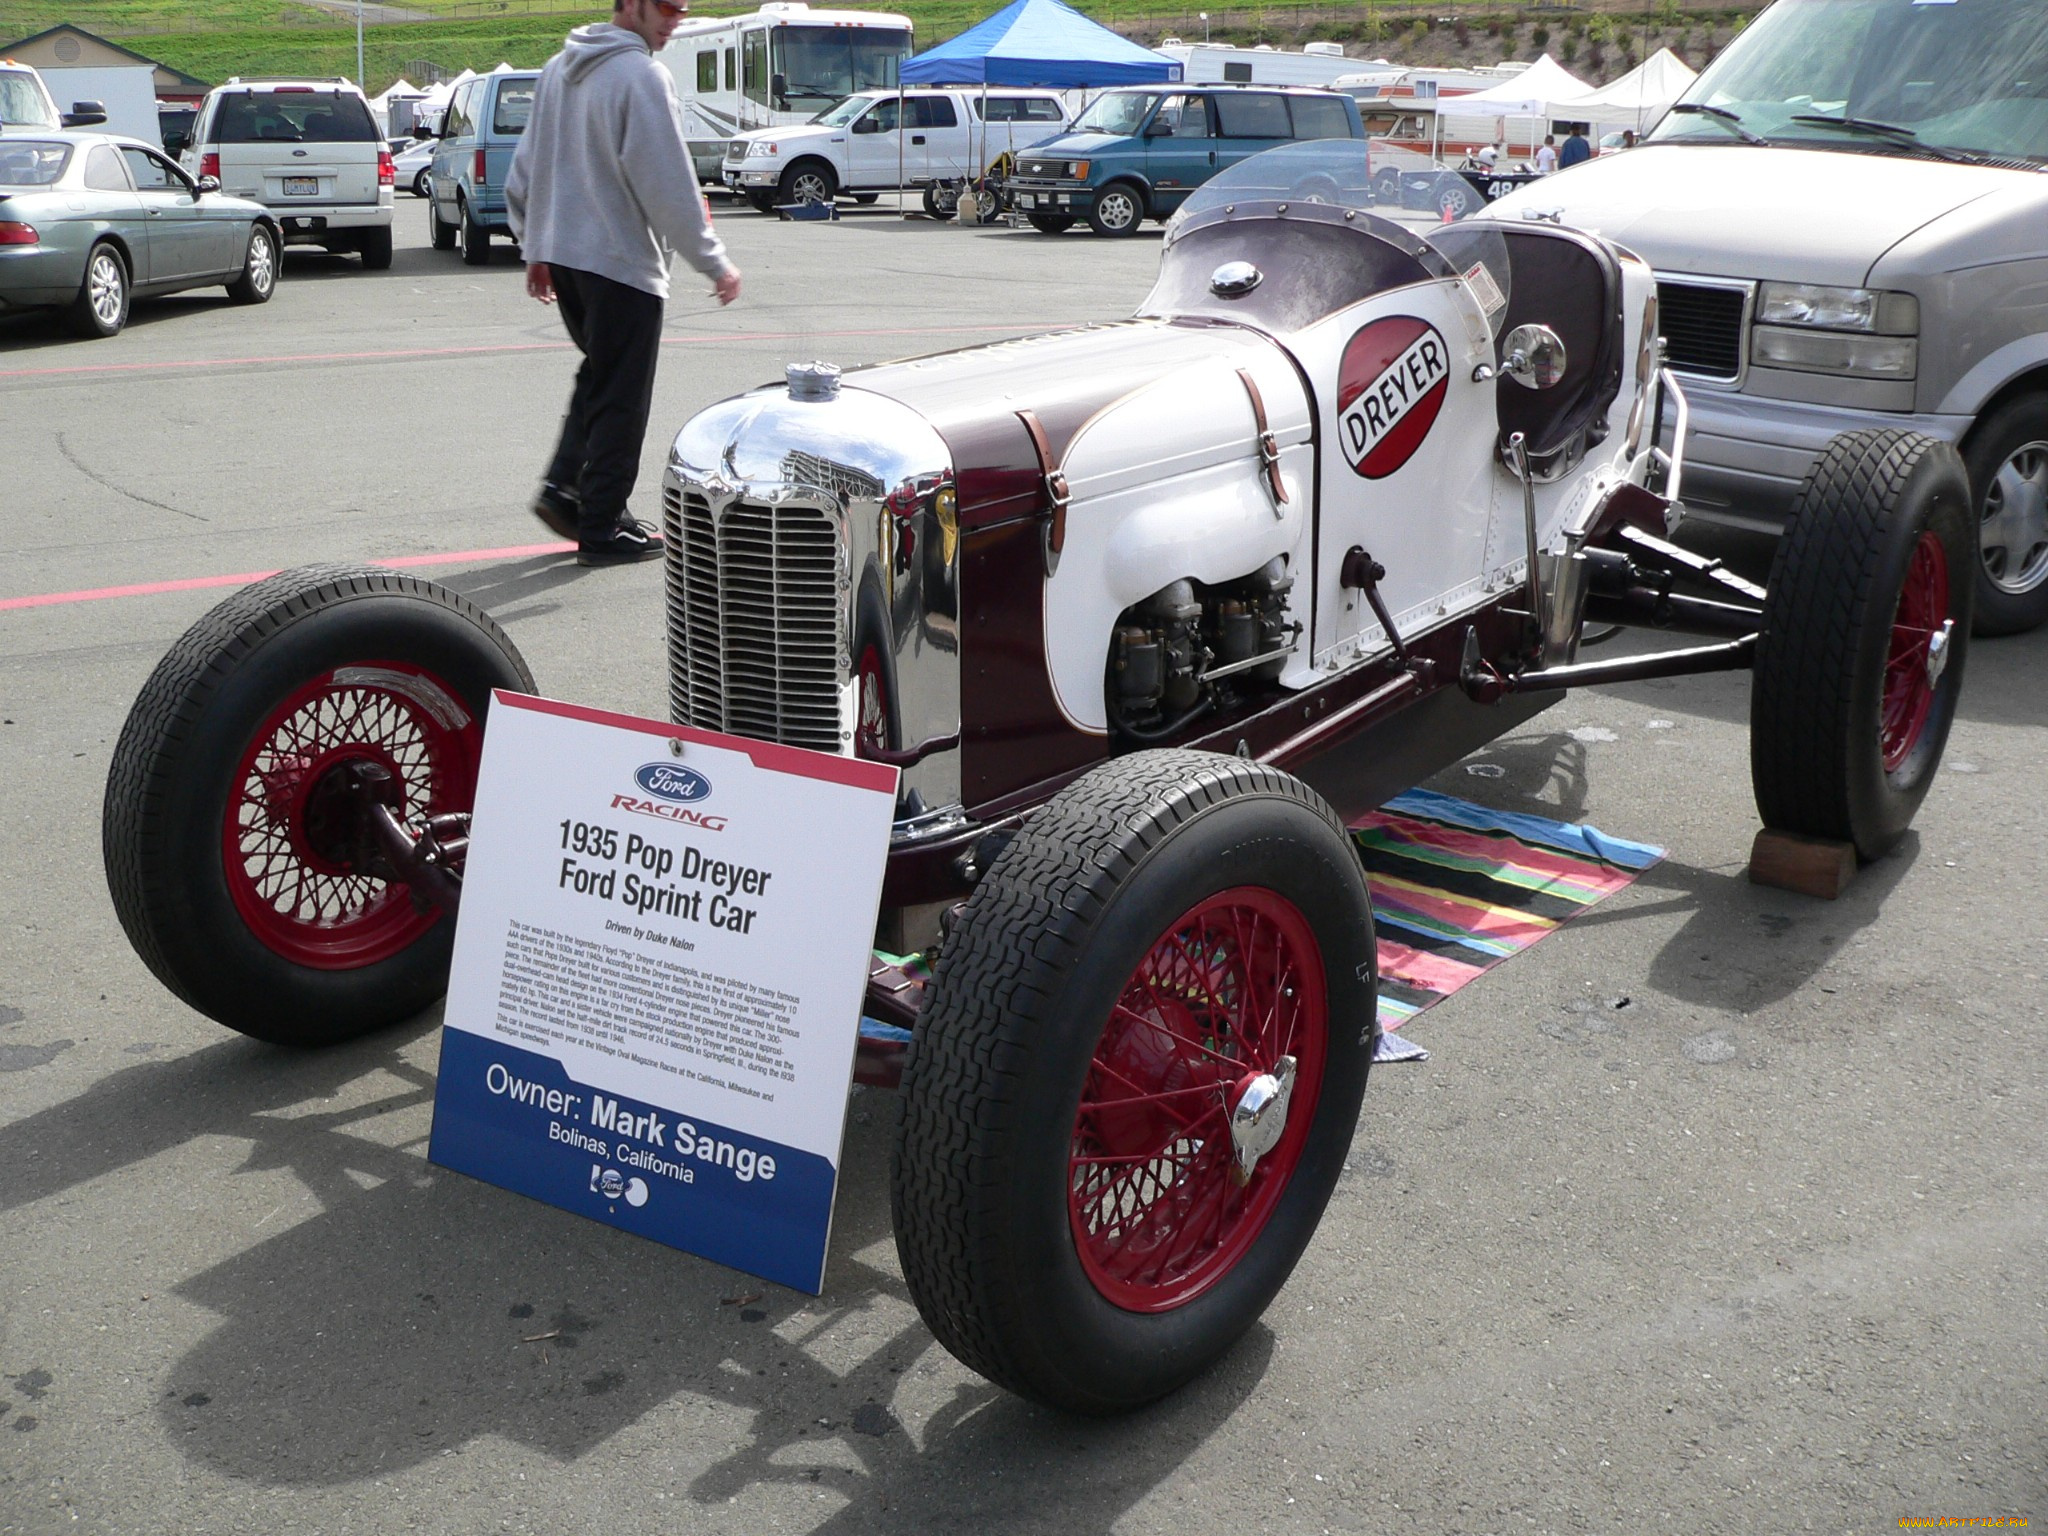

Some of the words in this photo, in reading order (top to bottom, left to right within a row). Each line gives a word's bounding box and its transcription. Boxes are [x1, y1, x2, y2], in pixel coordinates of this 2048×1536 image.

[1346, 340, 1443, 456] DREYER
[610, 794, 728, 831] RACING
[649, 767, 697, 797] Ford
[560, 819, 618, 860] 1935
[625, 834, 672, 879] Pop
[681, 846, 771, 896] Dreyer
[560, 858, 616, 900] Ford
[622, 873, 702, 922] Sprint
[709, 893, 756, 934] Car
[510, 919, 520, 929] This
[531, 927, 542, 935] was
[543, 929, 555, 938] built
[564, 935, 573, 943] the
[574, 937, 601, 952] legendary
[602, 944, 617, 955] Floyd
[636, 953, 655, 965] Dreyer
[701, 972, 712, 980] and
[714, 976, 726, 984] was
[727, 979, 748, 990] piloted
[758, 987, 775, 999] many
[777, 990, 799, 1004] famous
[520, 933, 538, 944] drivers
[546, 940, 554, 949] the
[574, 946, 584, 957] and
[605, 956, 633, 972] According
[642, 966, 651, 975] the
[652, 968, 671, 980] Dreyer
[693, 980, 703, 989] this
[712, 985, 721, 994] the
[723, 988, 735, 998] first
[605, 919, 632, 935] Driven
[633, 927, 644, 940] by
[646, 930, 668, 944] Duke
[669, 936, 694, 951] Nalon
[520, 1005, 529, 1015] The
[530, 1010, 547, 1021] record
[566, 1020, 579, 1030] from
[522, 954, 531, 963] The
[568, 967, 576, 976] the
[591, 974, 602, 983] had
[655, 991, 674, 1003] Dreyer
[675, 998, 690, 1008] nose
[713, 1007, 733, 1019] Dreyer
[734, 1014, 764, 1028] pioneered
[766, 1022, 775, 1031] his
[777, 1025, 799, 1038] famous
[555, 975, 569, 985] head
[570, 979, 588, 990] design
[598, 987, 607, 995] the
[624, 993, 637, 1004] Ford
[668, 1008, 687, 1018] engine
[689, 1012, 701, 1022] that
[702, 1017, 728, 1029] powered
[729, 1023, 740, 1033] this
[755, 1029, 765, 1040] The
[767, 1033, 781, 1044] 300-
[559, 954, 577, 965] Dreyer
[578, 960, 590, 969] built
[591, 963, 599, 971] for
[652, 980, 663, 989] and
[719, 998, 727, 1007] its
[729, 1002, 749, 1013] unique
[775, 1014, 790, 1024] nose
[559, 986, 568, 995] this
[570, 990, 588, 1001] engine
[601, 998, 609, 1006] far
[610, 1002, 619, 1011] cry
[621, 1004, 633, 1014] from
[635, 1008, 644, 1017] the
[662, 1016, 693, 1030] production
[694, 1026, 714, 1037] engine
[716, 1030, 728, 1040] that
[729, 1035, 758, 1049] produced
[495, 1023, 519, 1036] Michigan
[497, 1012, 507, 1022] This
[551, 1030, 564, 1039] each
[565, 1035, 577, 1043] year
[585, 1040, 594, 1049] the
[595, 1042, 616, 1056] Vintage
[617, 1049, 630, 1059] Oval
[631, 1053, 658, 1068] Magazine
[659, 1061, 677, 1073] Races
[686, 1070, 695, 1079] the
[762, 1093, 774, 1102] and
[538, 990, 549, 1000] This
[560, 998, 570, 1006] and
[702, 1035, 722, 1050] Dreyer
[724, 1045, 736, 1053] with
[738, 1047, 754, 1059] Duke
[755, 1052, 773, 1064] Nalon
[784, 1061, 793, 1070] the
[540, 1002, 555, 1012] Nalon
[567, 1010, 575, 1018] the
[602, 1020, 612, 1029] dirt
[613, 1023, 627, 1033] track
[629, 1029, 647, 1039] record
[655, 1035, 669, 1046] 24.5
[670, 1041, 694, 1053] seconds
[747, 1062, 767, 1076] during
[769, 1068, 779, 1077] the
[487, 1064, 580, 1119] Owner:
[591, 1095, 665, 1146] Mark
[674, 1122, 775, 1181] Sange
[549, 1121, 610, 1159] Bolinas,
[617, 1144, 693, 1183] California
